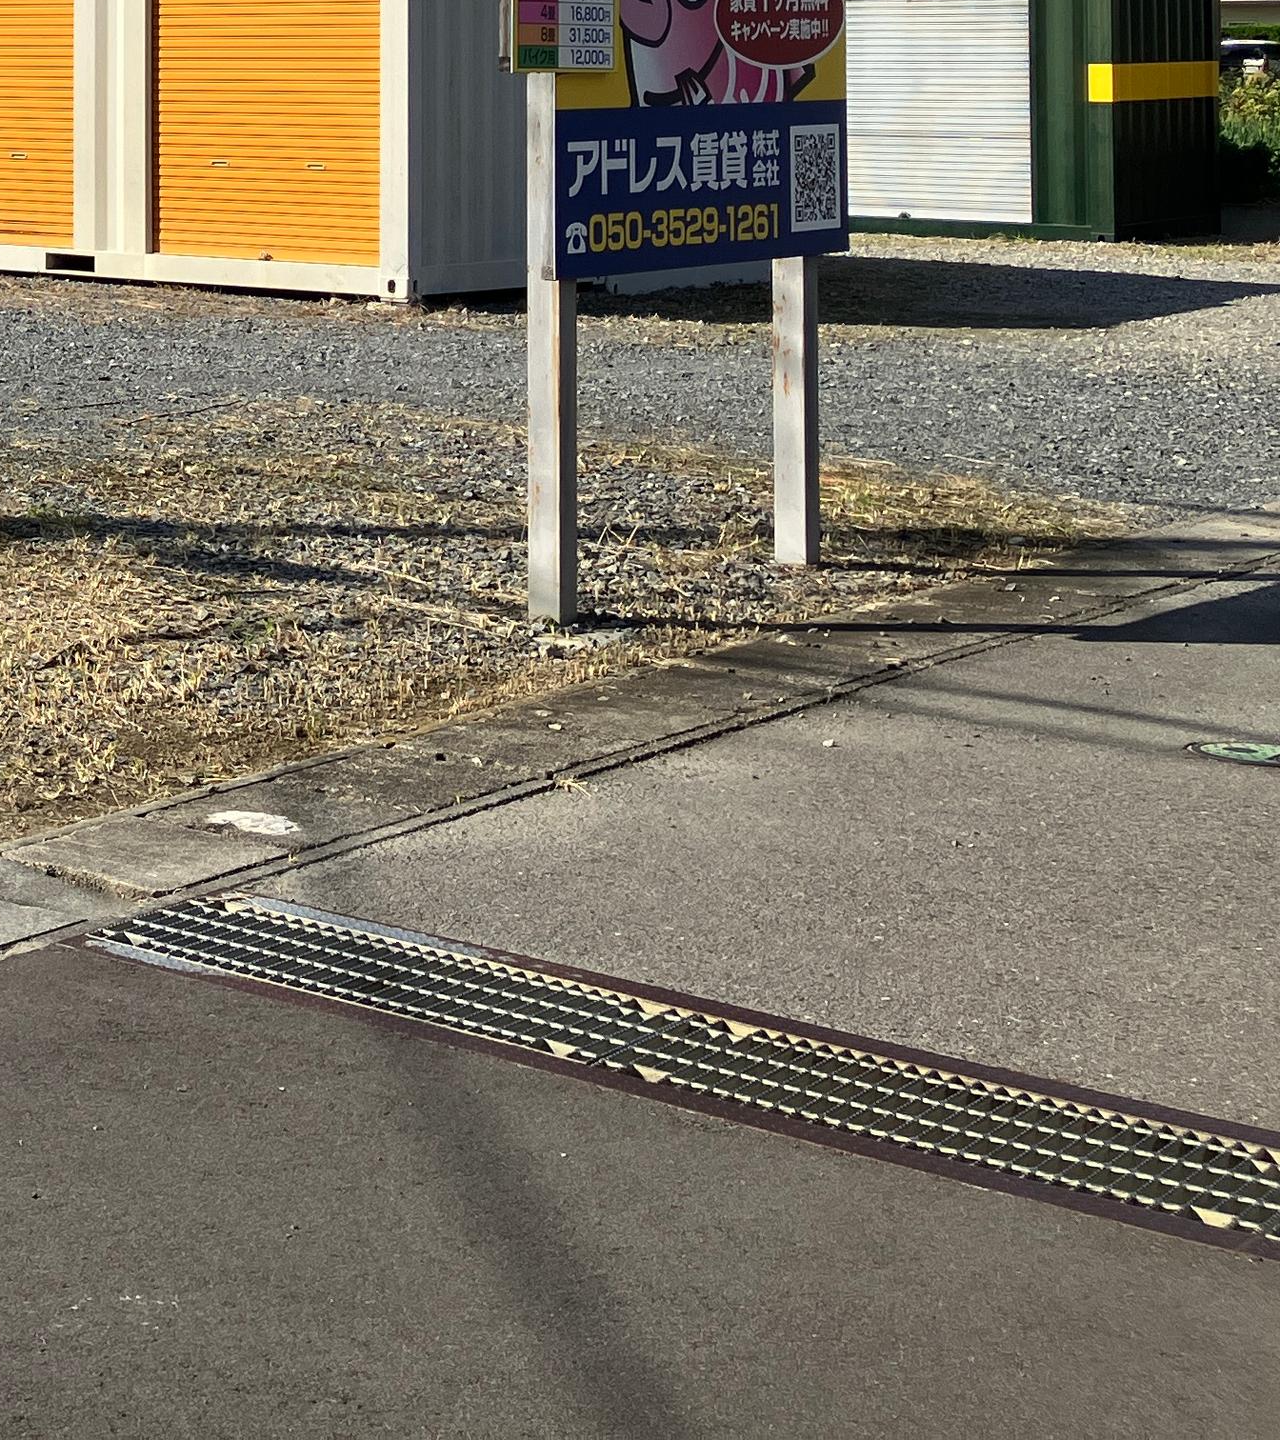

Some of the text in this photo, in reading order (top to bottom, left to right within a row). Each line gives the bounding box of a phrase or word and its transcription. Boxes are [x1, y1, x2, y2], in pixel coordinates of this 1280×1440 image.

[730, 17, 829, 42] キャンペーン実施中!!
[751, 129, 780, 158] 株式
[566, 130, 748, 198] アドレス賃貸
[751, 159, 780, 188] 会社
[589, 203, 779, 253] 050-3529-1261
